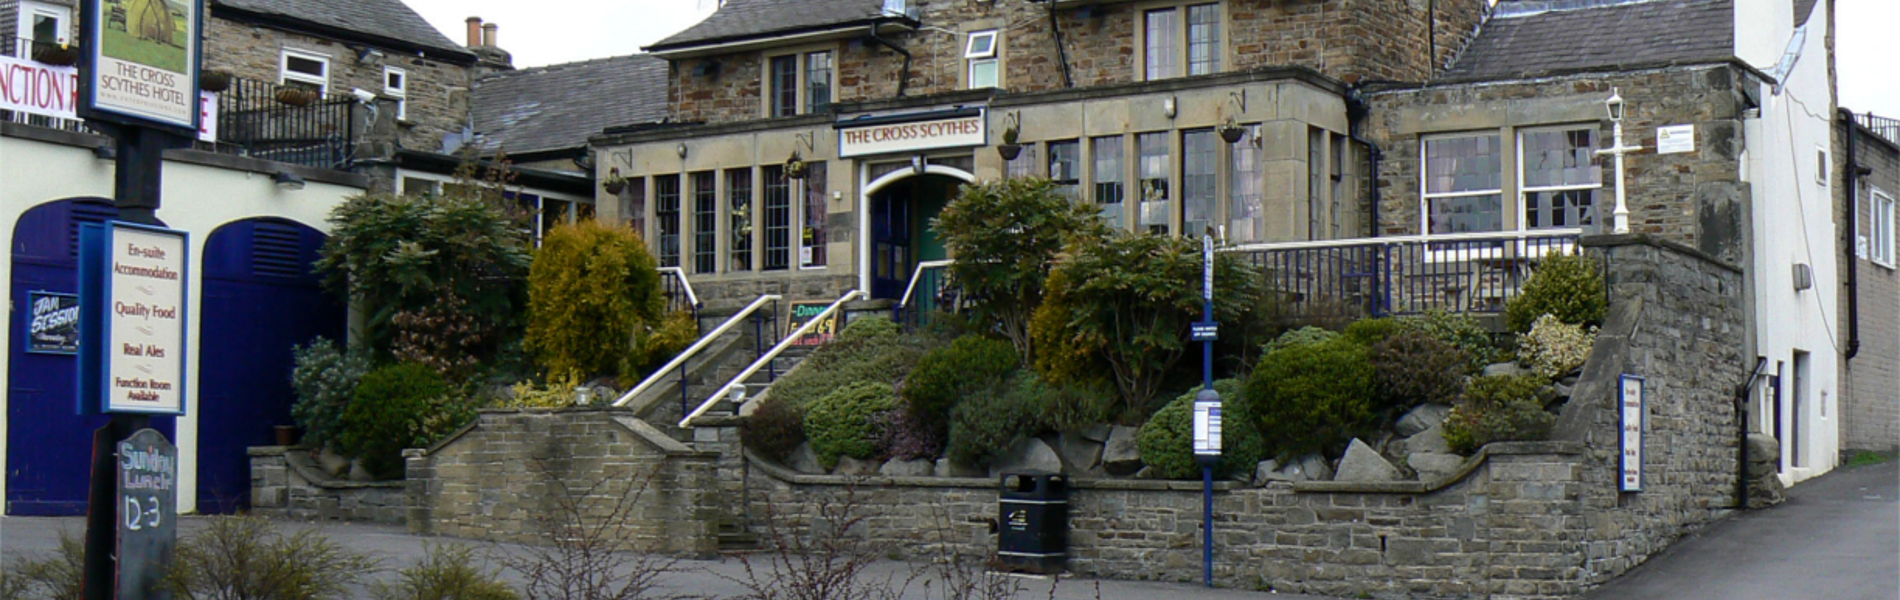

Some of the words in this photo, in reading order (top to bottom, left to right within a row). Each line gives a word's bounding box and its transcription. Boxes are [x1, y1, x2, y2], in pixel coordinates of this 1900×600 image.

[116, 62, 138, 79] THE
[140, 67, 176, 88] CROSS
[101, 74, 151, 98] SCYTHES
[153, 87, 186, 107] HOTEL
[844, 130, 871, 145] THE
[873, 125, 918, 142] CROSS
[920, 119, 979, 138] SCYTHES
[128, 243, 166, 260] En-suite
[114, 261, 178, 280] Accommodation
[115, 301, 151, 320] Quality
[152, 305, 176, 319] Food
[123, 343, 143, 357] Real
[145, 344, 165, 358] Ales
[115, 377, 147, 390] Function
[150, 379, 171, 390] Room
[127, 390, 160, 402] Available
[121, 442, 174, 480] Sunday
[125, 470, 173, 491] Lunch
[125, 495, 161, 530] 12-3
